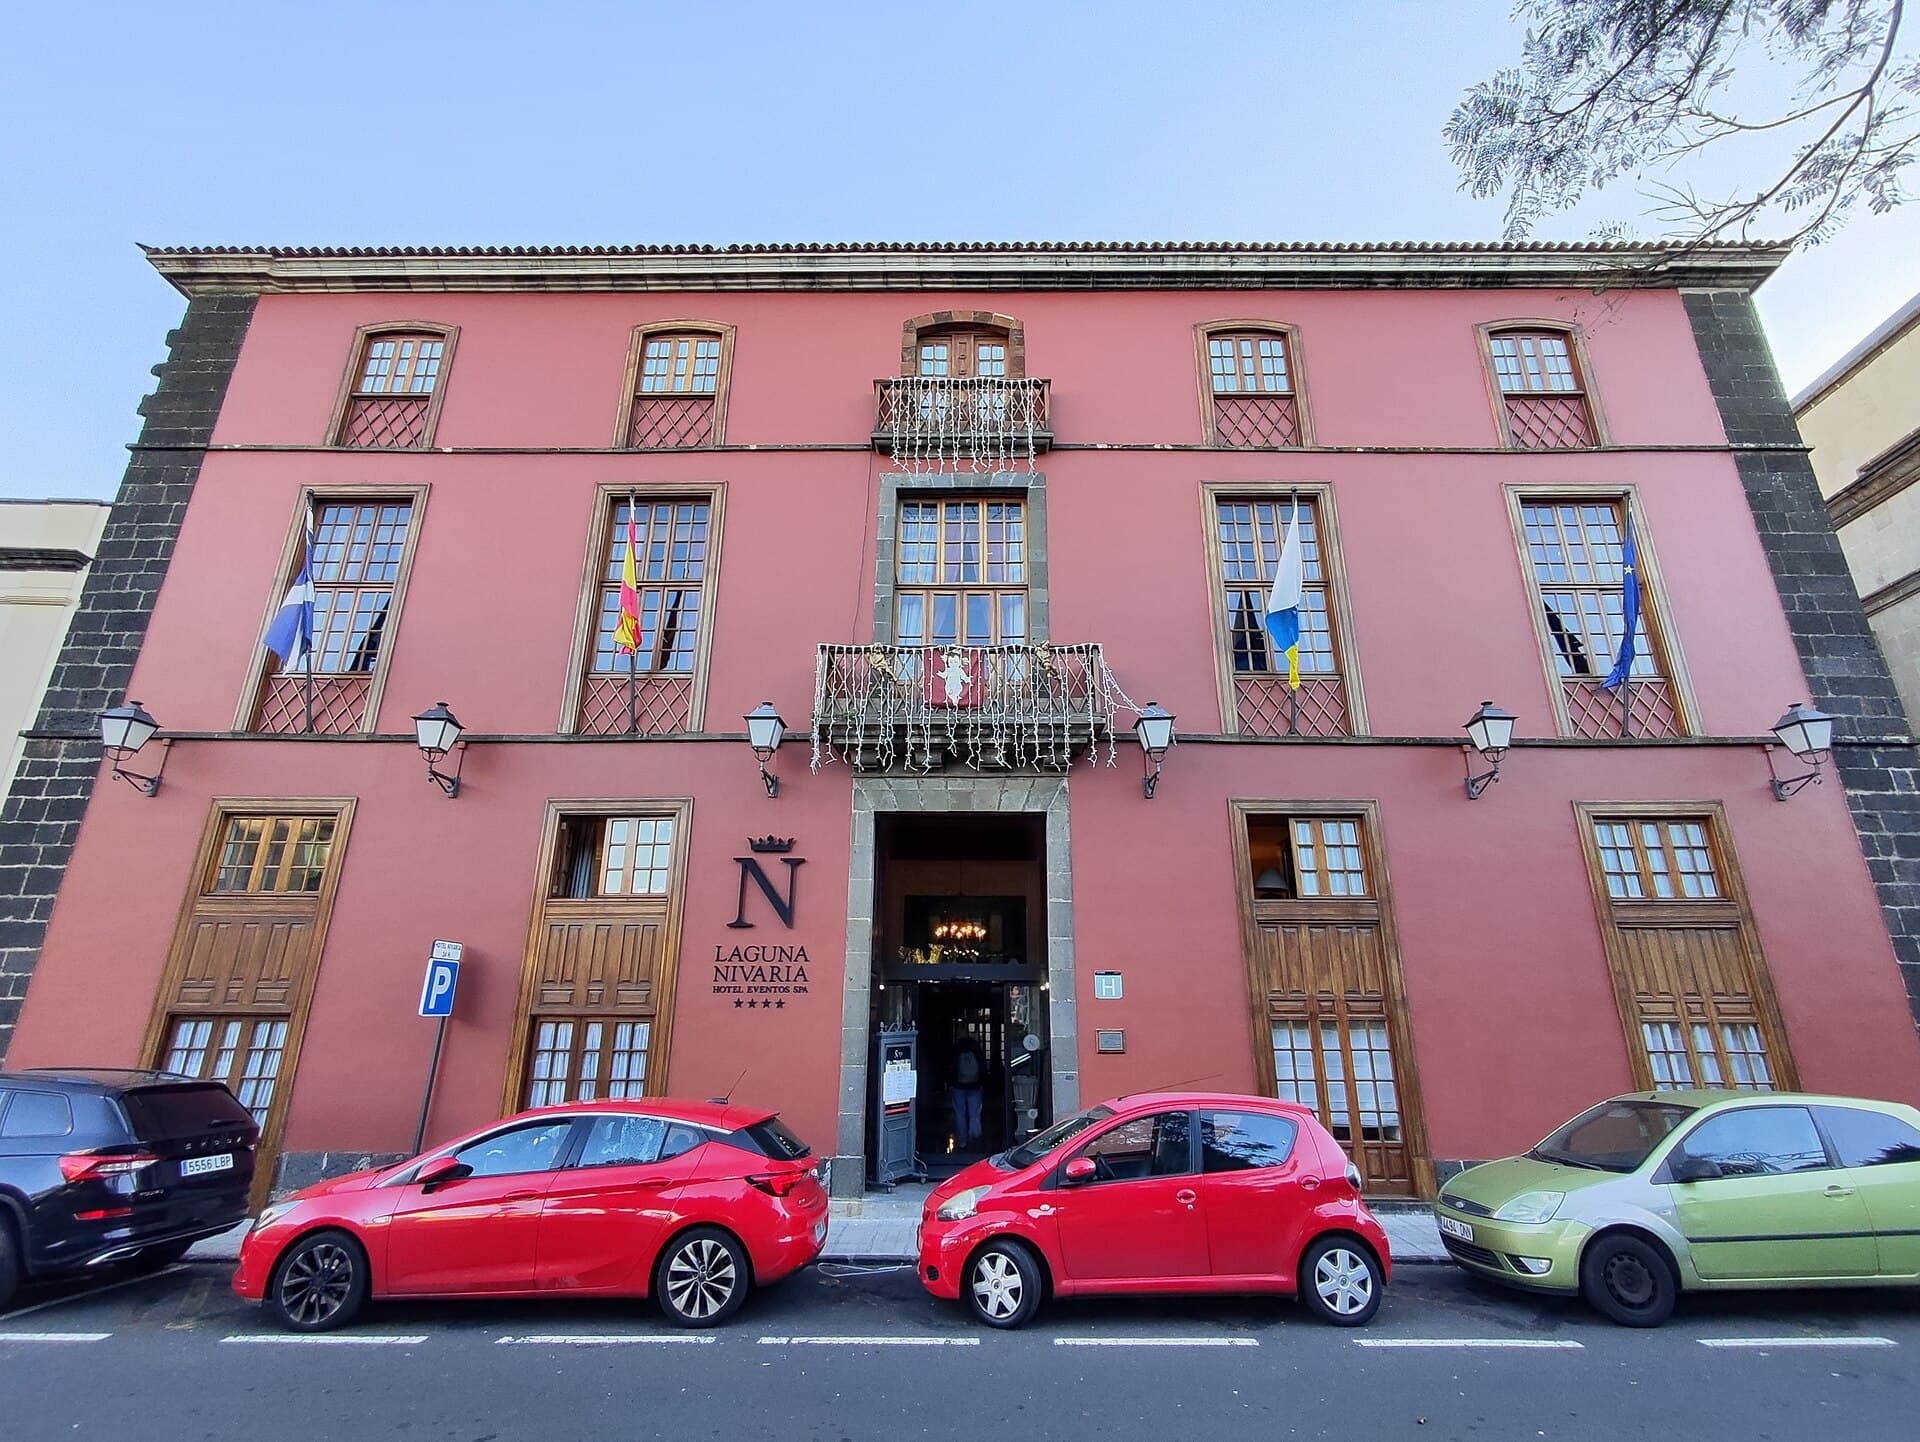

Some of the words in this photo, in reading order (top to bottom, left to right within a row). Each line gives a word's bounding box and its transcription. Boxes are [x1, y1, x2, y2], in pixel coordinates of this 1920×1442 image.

[715, 945, 810, 963] LAGUNA
[713, 966, 809, 983] NIVARIA
[428, 966, 452, 1009] P
[712, 985, 744, 994] HOTEL
[747, 985, 790, 994] EVENTOS
[793, 985, 809, 994] SPA
[1102, 978, 1116, 997] H
[188, 1159, 213, 1173] 5556
[214, 1155, 231, 1168] LBP
